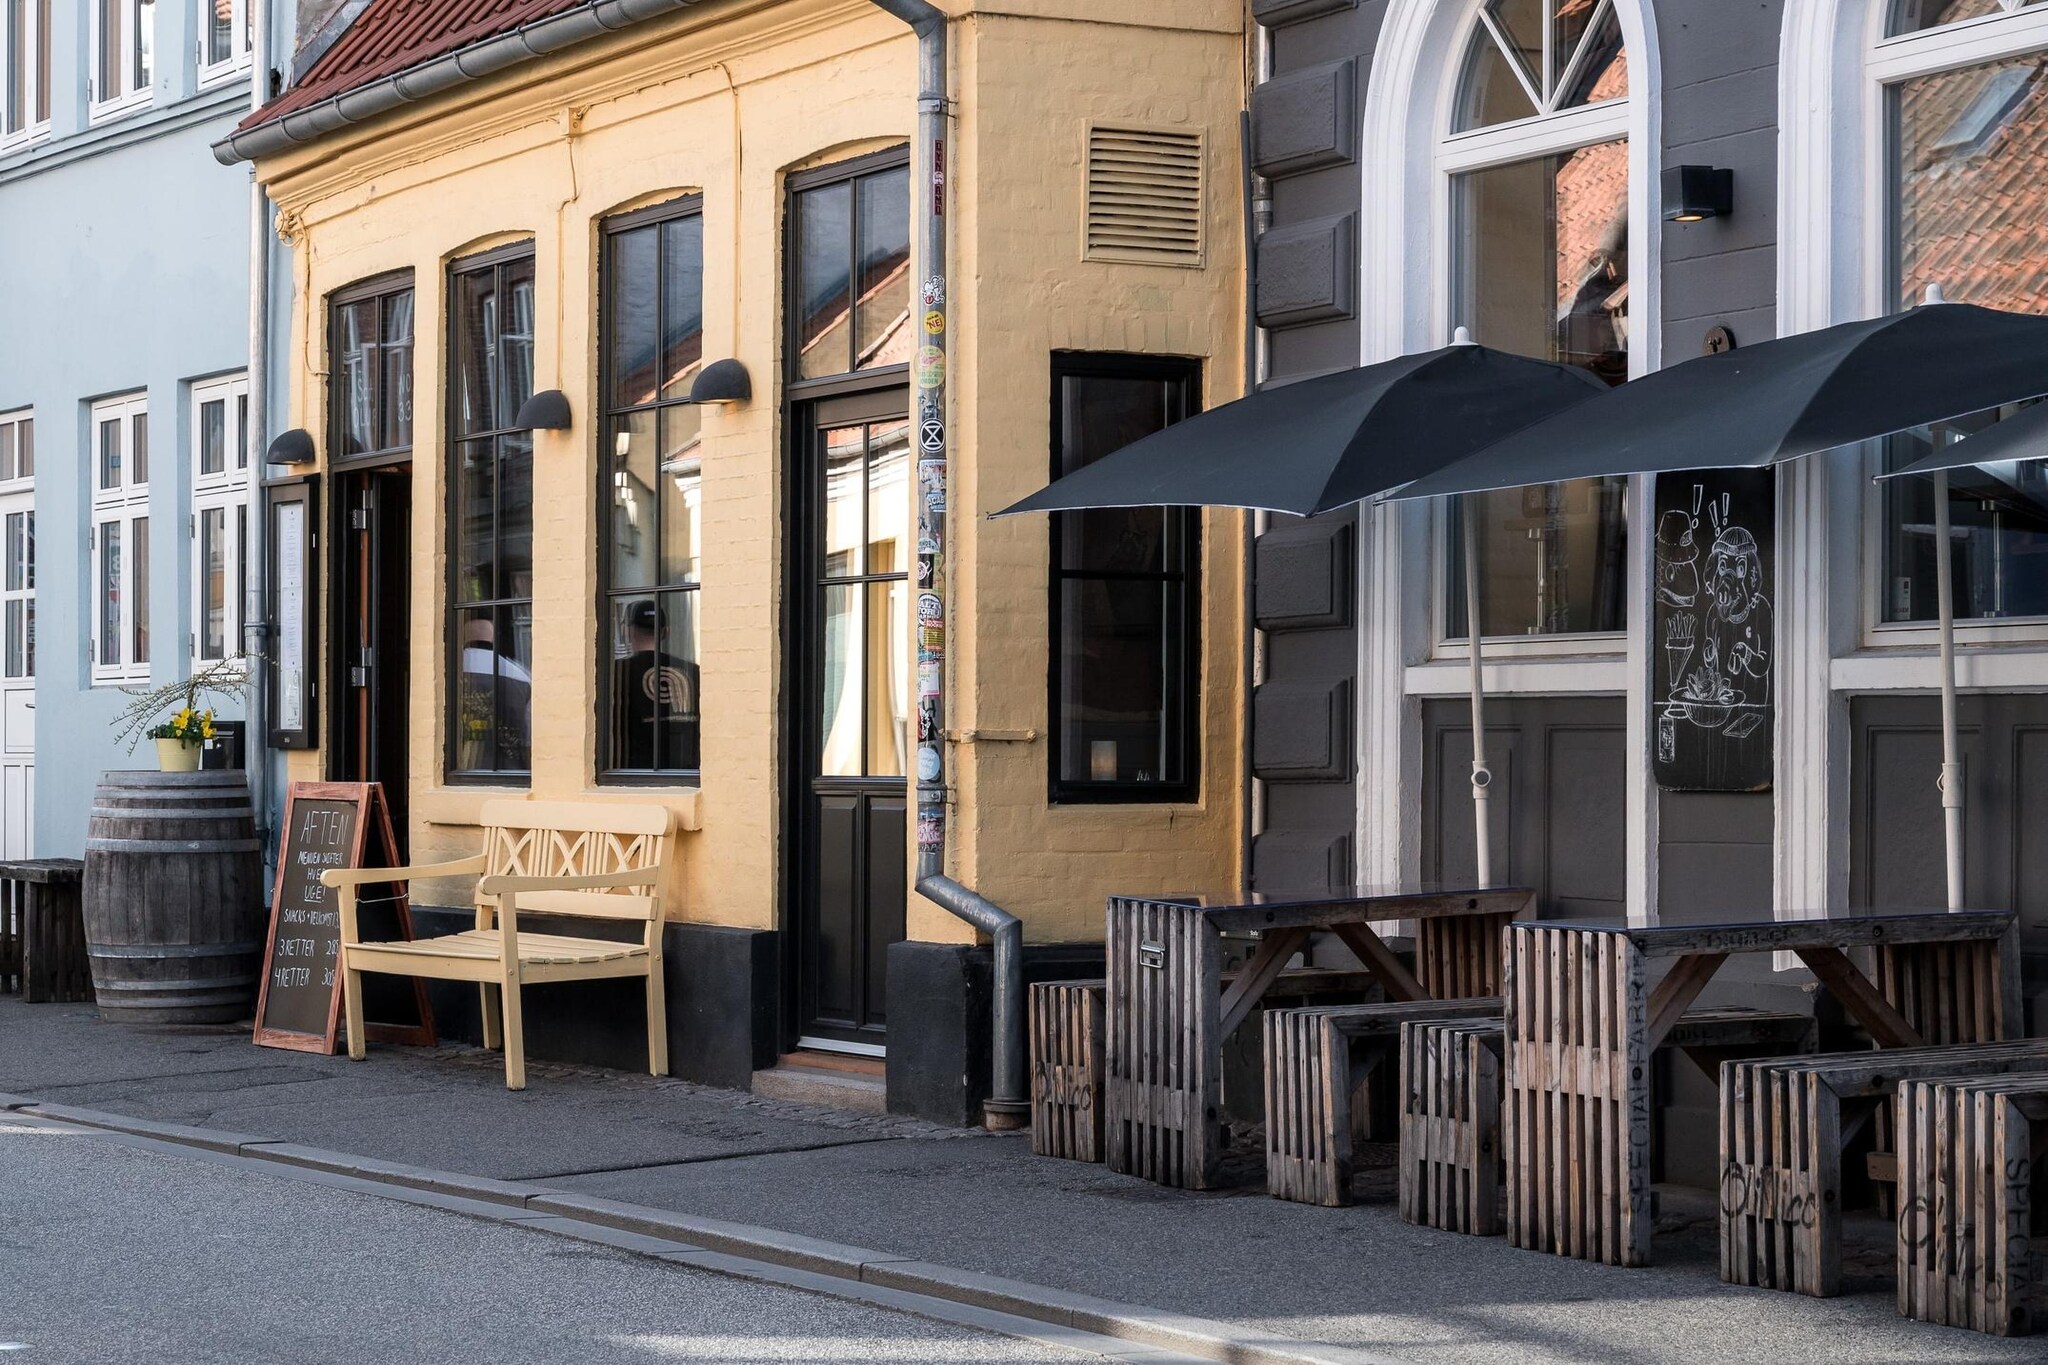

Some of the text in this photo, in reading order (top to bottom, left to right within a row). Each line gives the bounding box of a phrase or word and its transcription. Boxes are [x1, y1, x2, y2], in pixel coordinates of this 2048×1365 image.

[300, 811, 349, 846] AFTEN
[307, 868, 325, 881] HVE
[304, 885, 326, 902] UGE!
[283, 908, 306, 924] SNACKS
